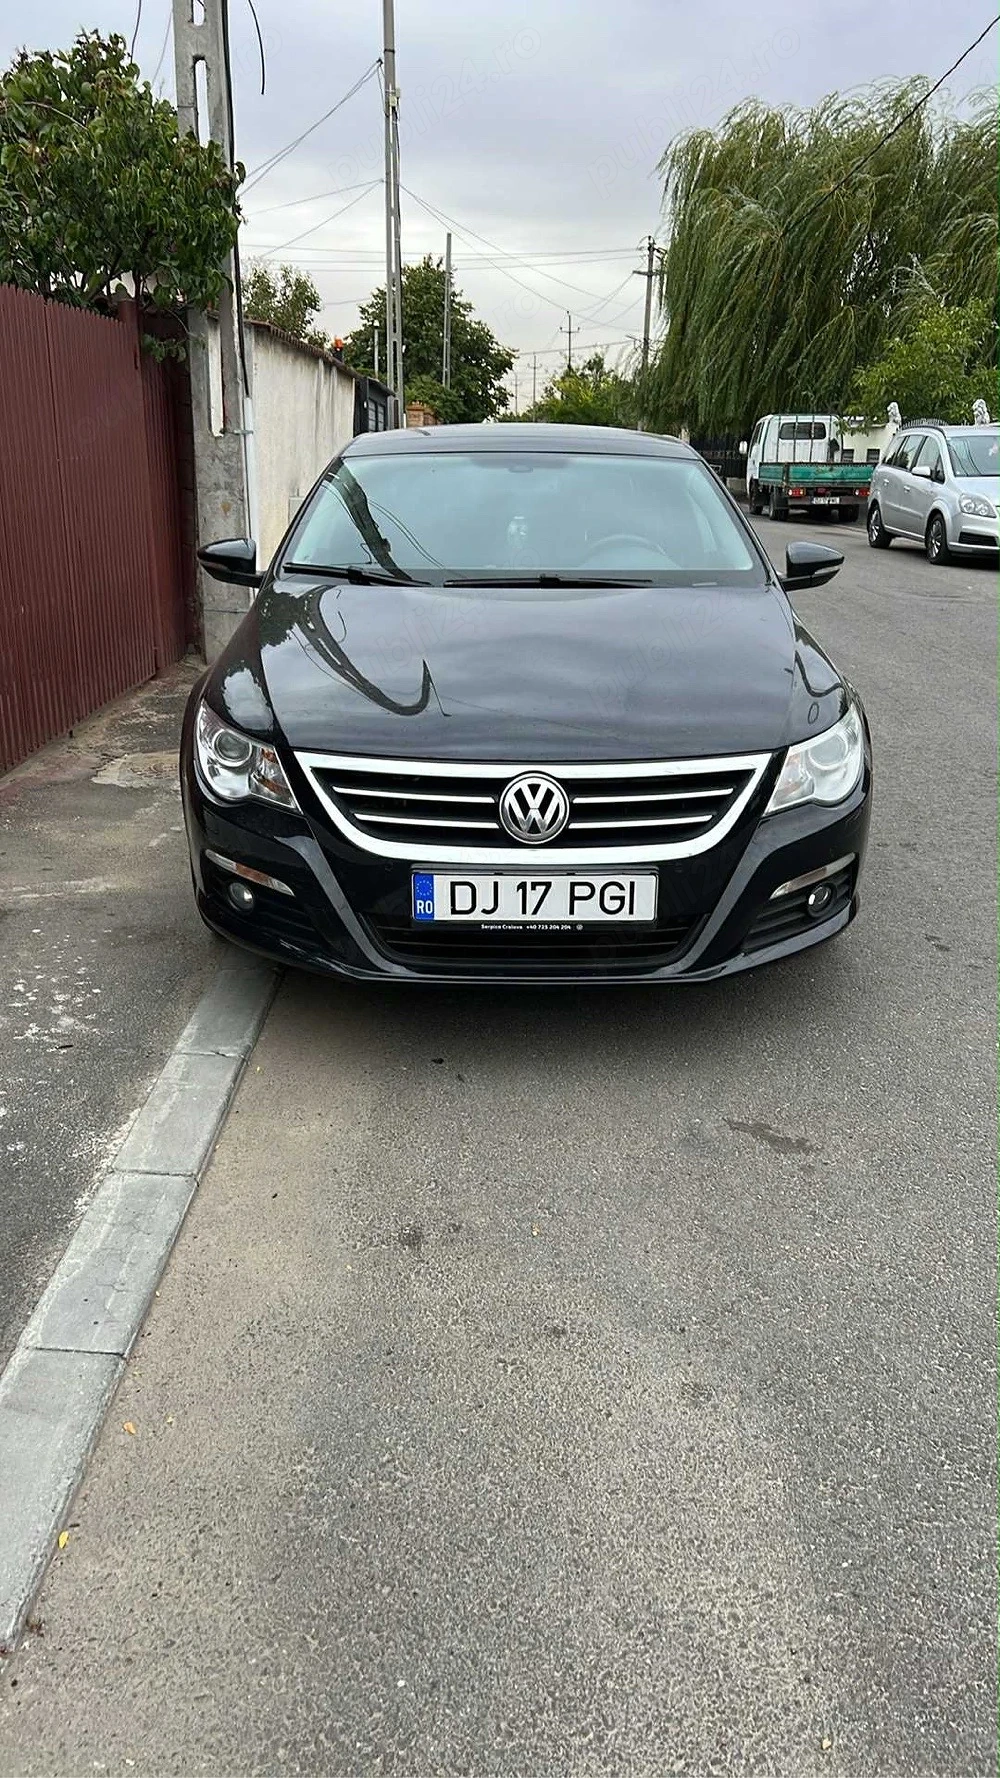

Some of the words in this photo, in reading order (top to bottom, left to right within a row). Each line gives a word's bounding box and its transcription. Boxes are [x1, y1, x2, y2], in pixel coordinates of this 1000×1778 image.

[502, 775, 566, 841] VW
[416, 900, 433, 914] RO
[450, 881, 499, 915] DJ
[516, 881, 552, 915] 17
[569, 881, 635, 915] PGI
